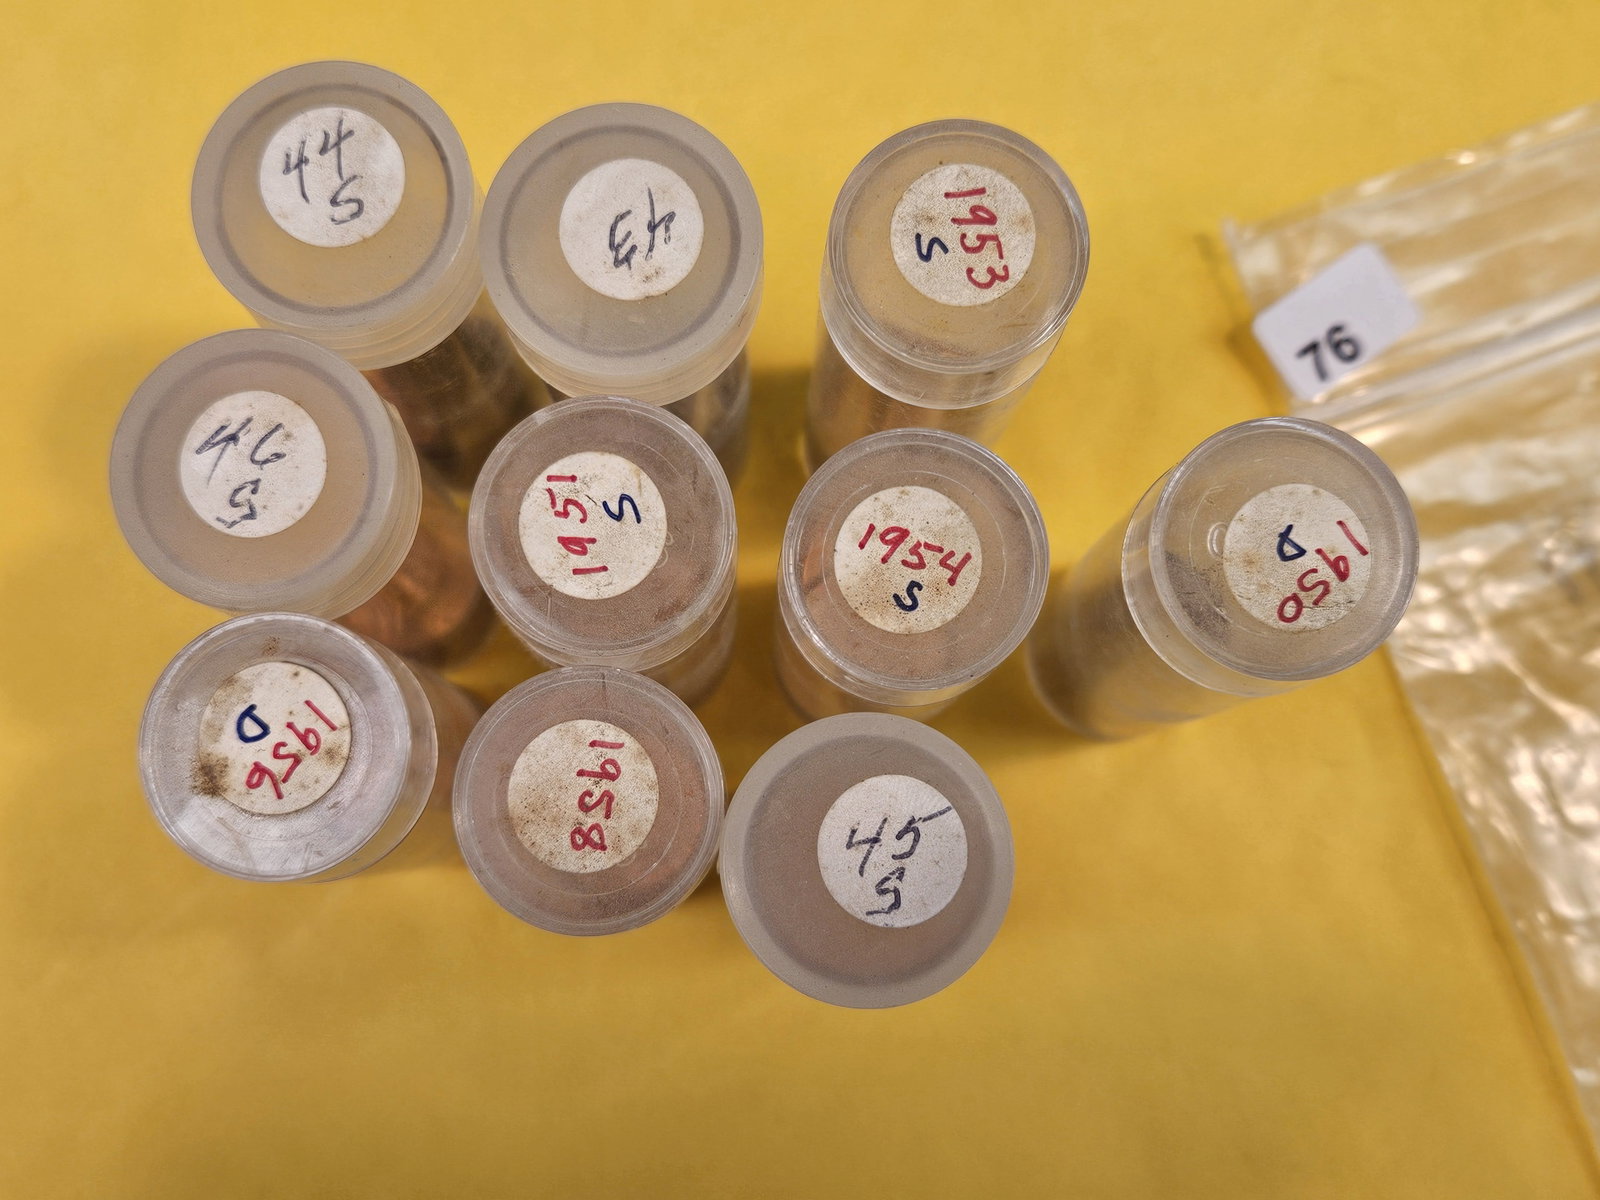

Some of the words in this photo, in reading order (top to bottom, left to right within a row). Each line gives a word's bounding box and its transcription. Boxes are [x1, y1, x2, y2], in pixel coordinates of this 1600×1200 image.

[282, 112, 354, 204] 44
[914, 233, 949, 262] S
[944, 187, 1009, 289] 1953
[1296, 322, 1361, 382] 76
[195, 416, 286, 487] 46
[544, 475, 608, 575] 1951
[602, 493, 641, 524] S
[1276, 524, 1307, 561] D
[858, 523, 972, 586] 1954
[1277, 520, 1368, 623] 1950
[892, 580, 923, 611] S
[236, 704, 271, 743] D
[246, 700, 338, 800] 1956
[570, 740, 625, 852] 1958
[846, 806, 952, 877] 45
